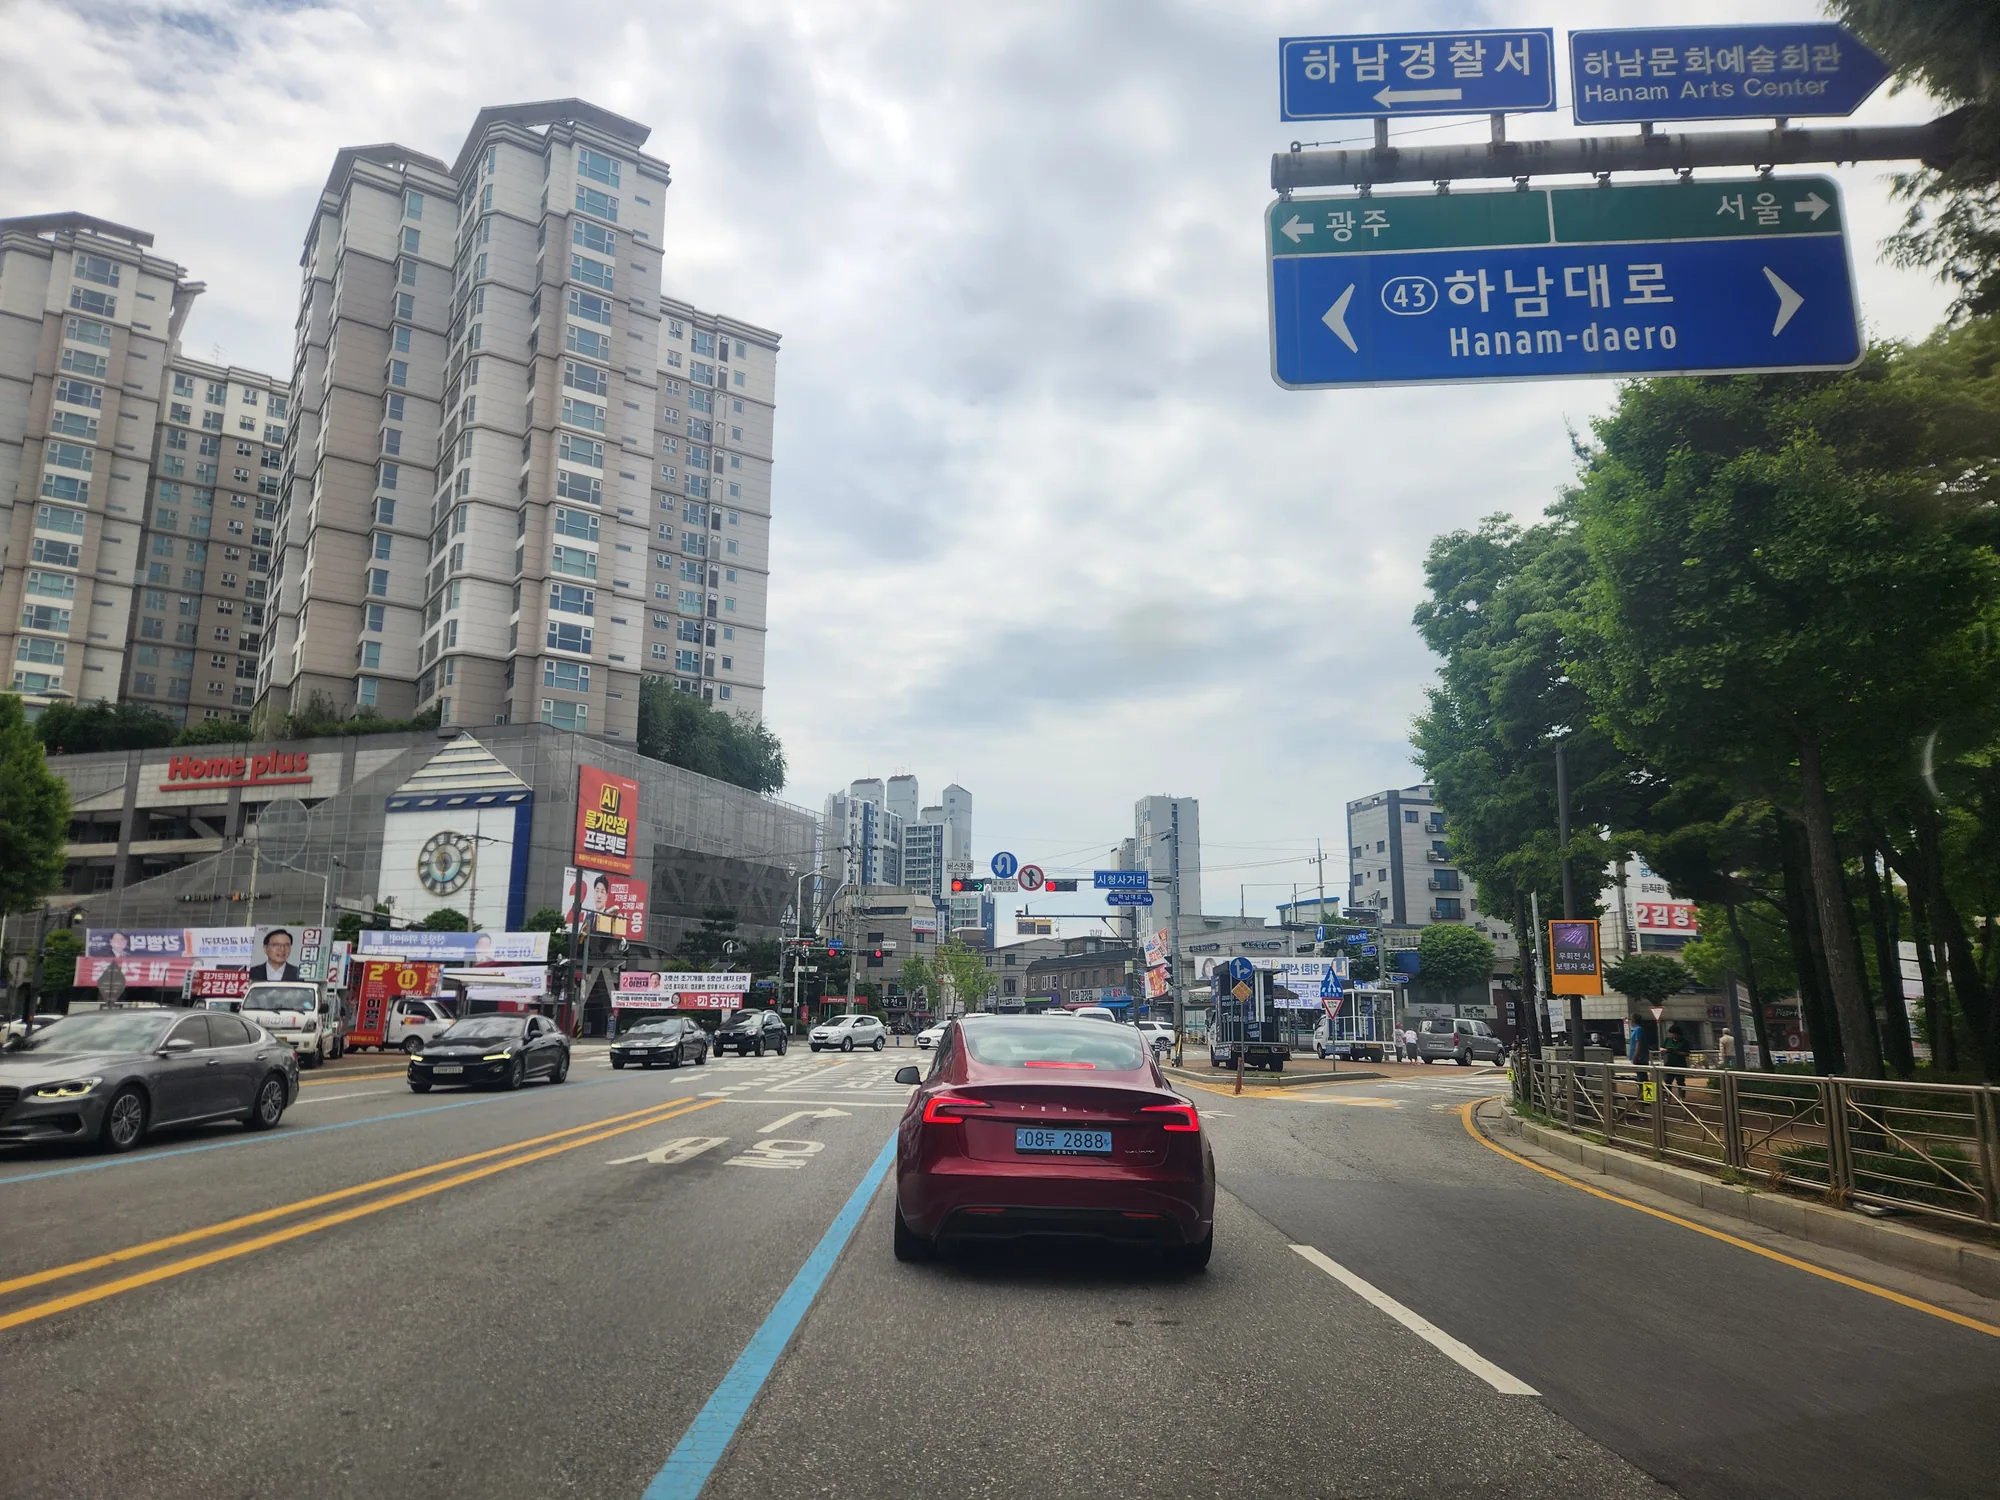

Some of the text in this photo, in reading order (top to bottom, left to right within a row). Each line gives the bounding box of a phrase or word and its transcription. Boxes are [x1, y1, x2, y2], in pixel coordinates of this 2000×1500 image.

[1303, 38, 1531, 84] 하남경찰서
[1583, 43, 1842, 78] 하남문화예술회관
[1585, 77, 1829, 103] Hanam Arts Center
[1716, 193, 1783, 225] 서울
[1326, 210, 1391, 242] 광주
[1392, 264, 1675, 318] 43 하남대로
[1450, 324, 1677, 357] Hanam-daero
[168, 750, 309, 783] Home plus
[601, 789, 617, 809] AI
[585, 810, 628, 836] 물가안정
[584, 830, 627, 855] 프로젝트
[947, 863, 972, 871] 버스전용
[1097, 875, 1145, 885] 시청사거리
[1559, 952, 1590, 960] 우회전 시
[709, 995, 741, 1008] 오지연
[1063, 1132, 1104, 1149] 2888
